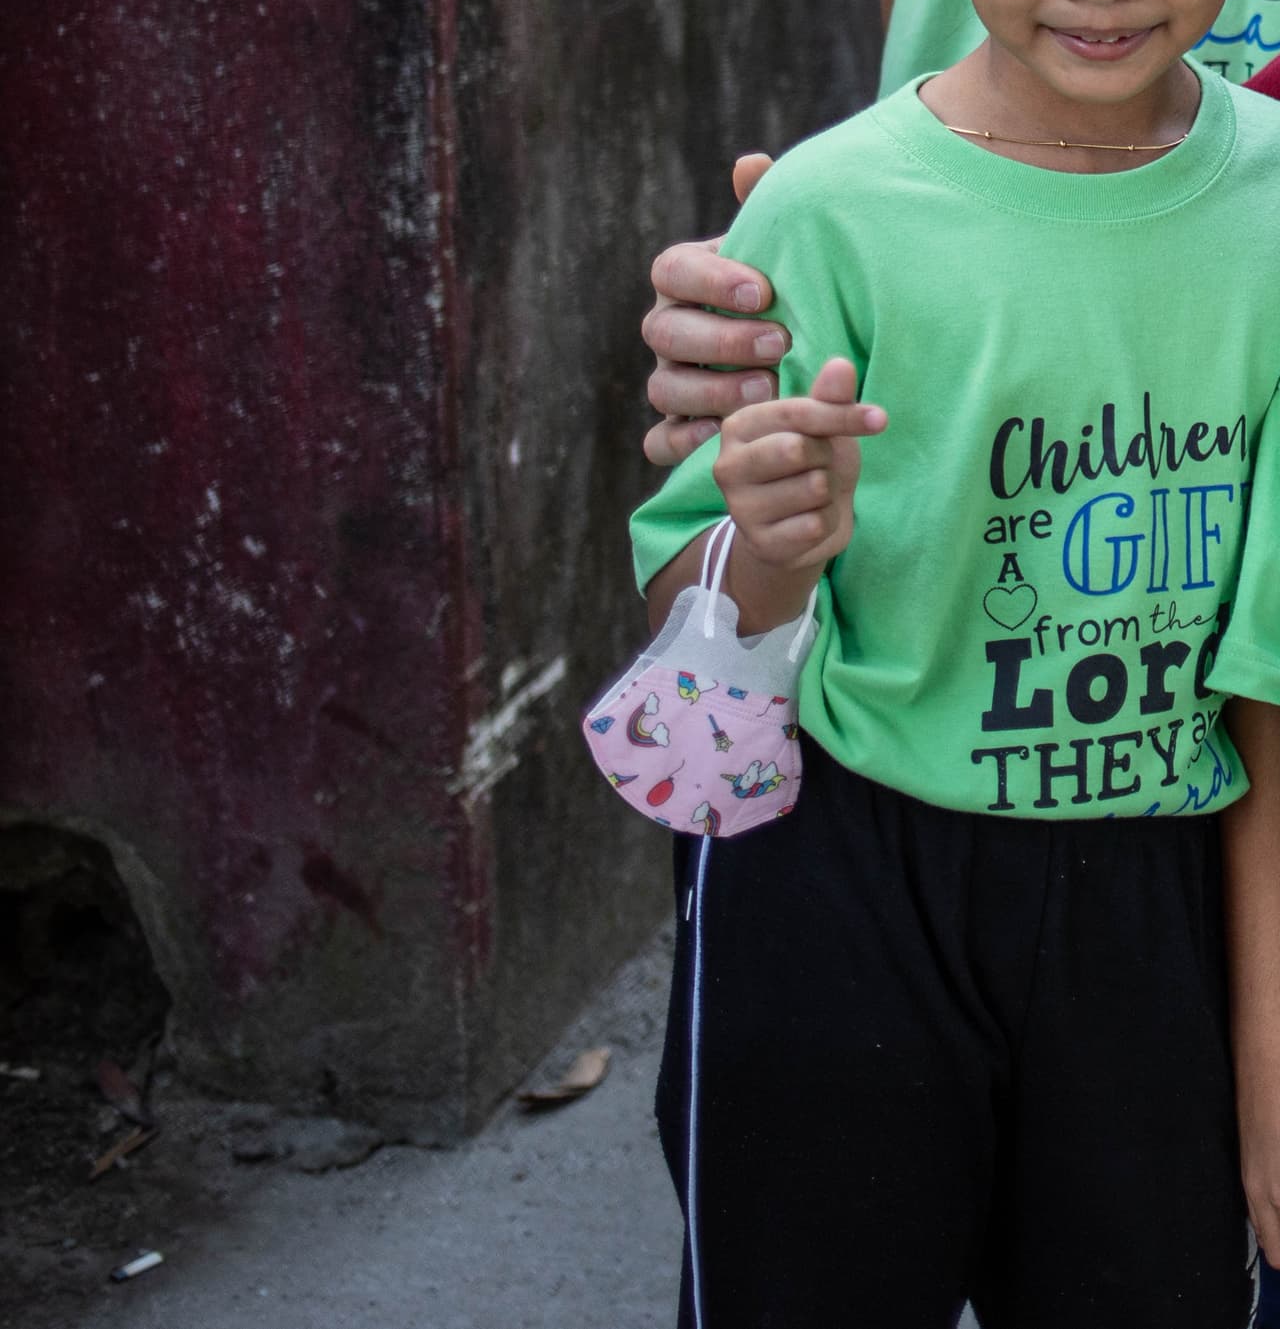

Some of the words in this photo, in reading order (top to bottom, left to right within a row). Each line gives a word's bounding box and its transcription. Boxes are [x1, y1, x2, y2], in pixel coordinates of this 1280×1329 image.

[990, 391, 1247, 500] Children
[983, 509, 1053, 545] are
[1063, 480, 1253, 596] GIF
[997, 553, 1024, 583] A
[1033, 615, 1140, 655] from
[1149, 600, 1216, 633] the
[971, 719, 1184, 810] THEY
